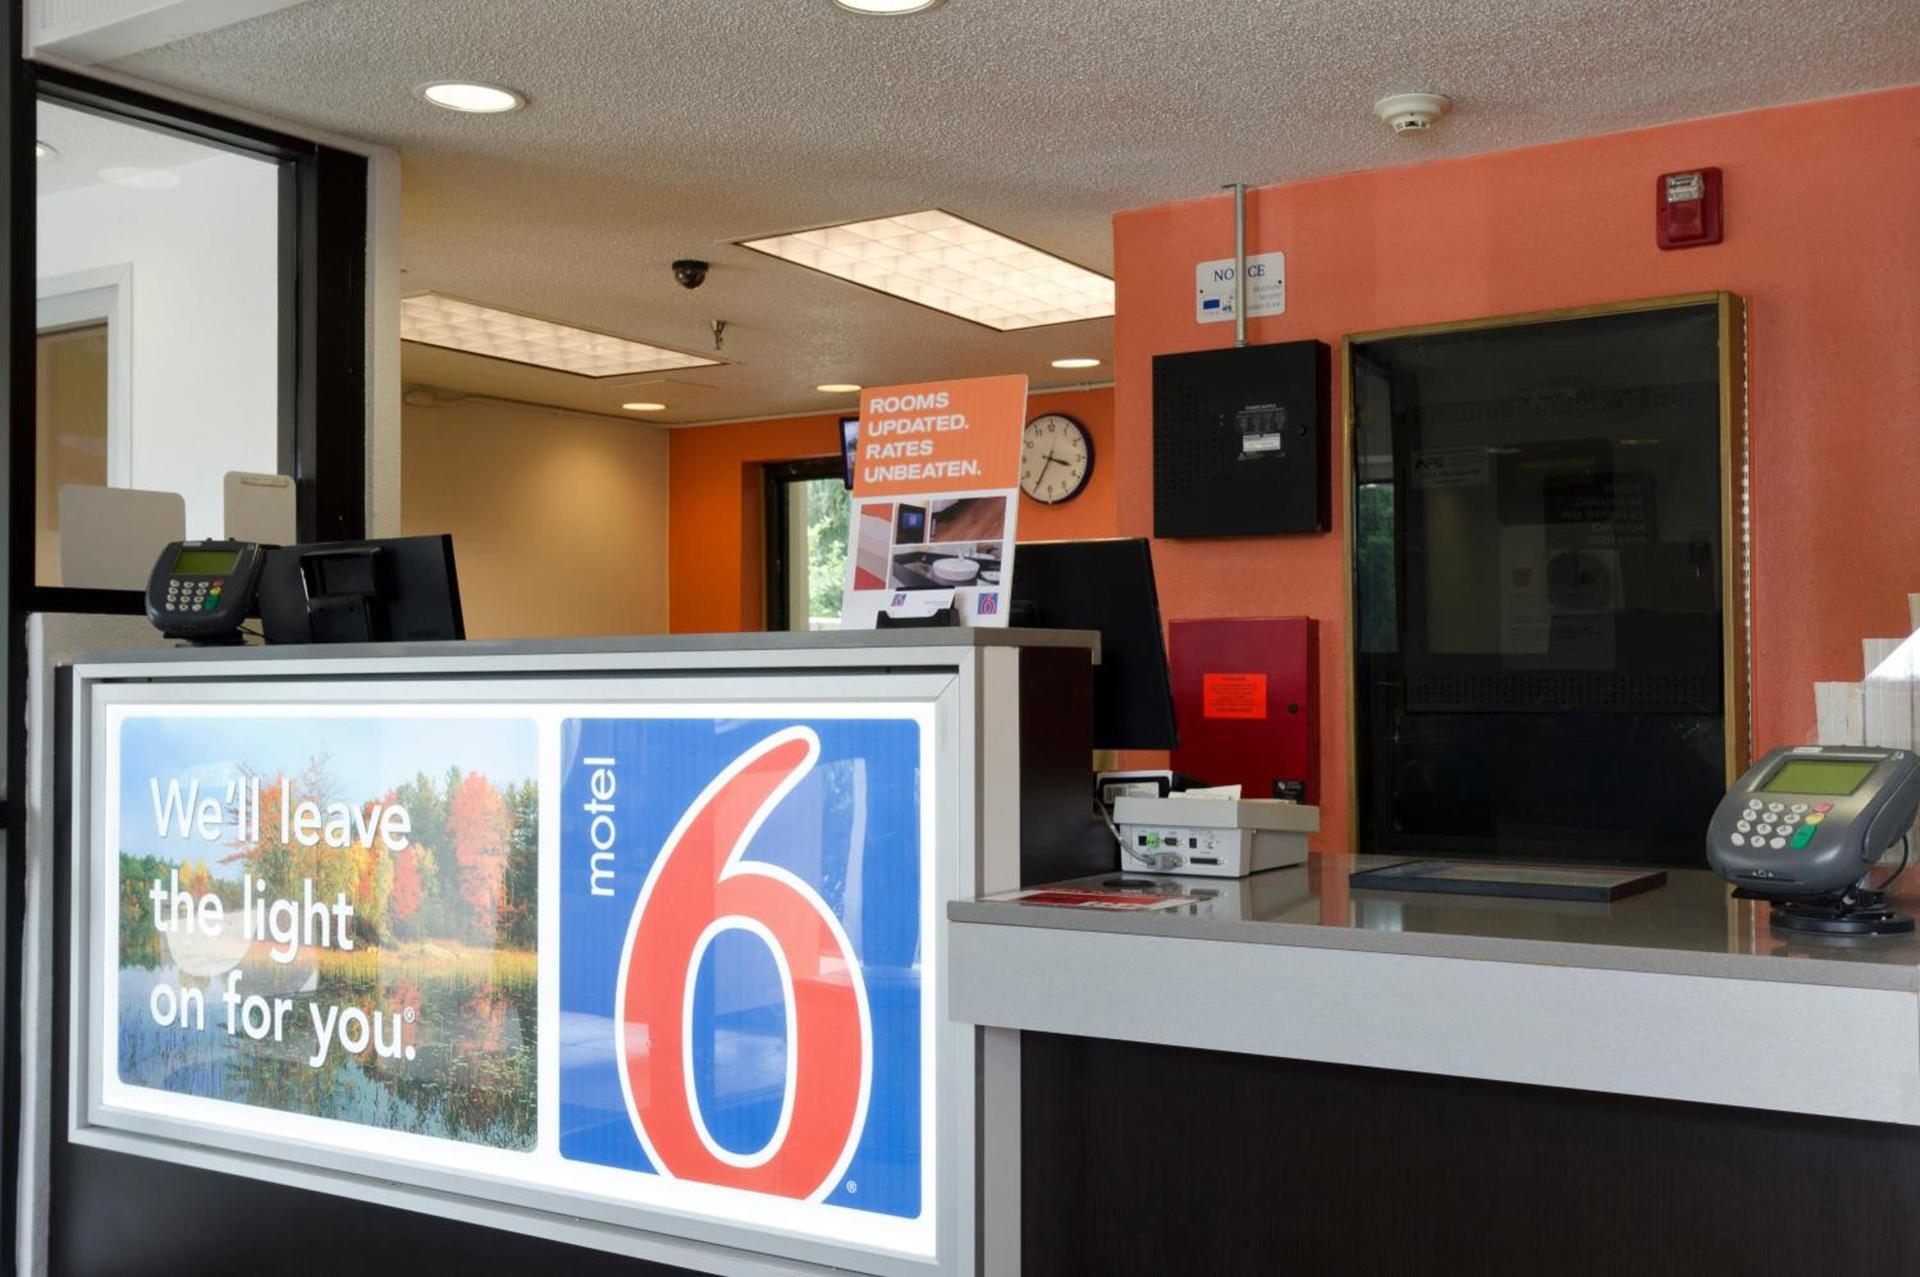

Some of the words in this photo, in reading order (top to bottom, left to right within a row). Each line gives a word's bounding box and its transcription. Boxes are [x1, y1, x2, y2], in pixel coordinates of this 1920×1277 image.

[1213, 264, 1265, 282] NOCE
[868, 413, 970, 437] UPDATED.
[870, 391, 950, 414] ROOMS
[864, 459, 982, 483] UNBEATEN.
[865, 439, 934, 460] RATES
[150, 776, 260, 843] We'll
[280, 777, 413, 851] leave
[583, 757, 616, 897] motel
[149, 869, 225, 938] the
[243, 873, 355, 964] light
[614, 725, 874, 1205] 6
[150, 984, 205, 1032] on
[223, 970, 294, 1042] for
